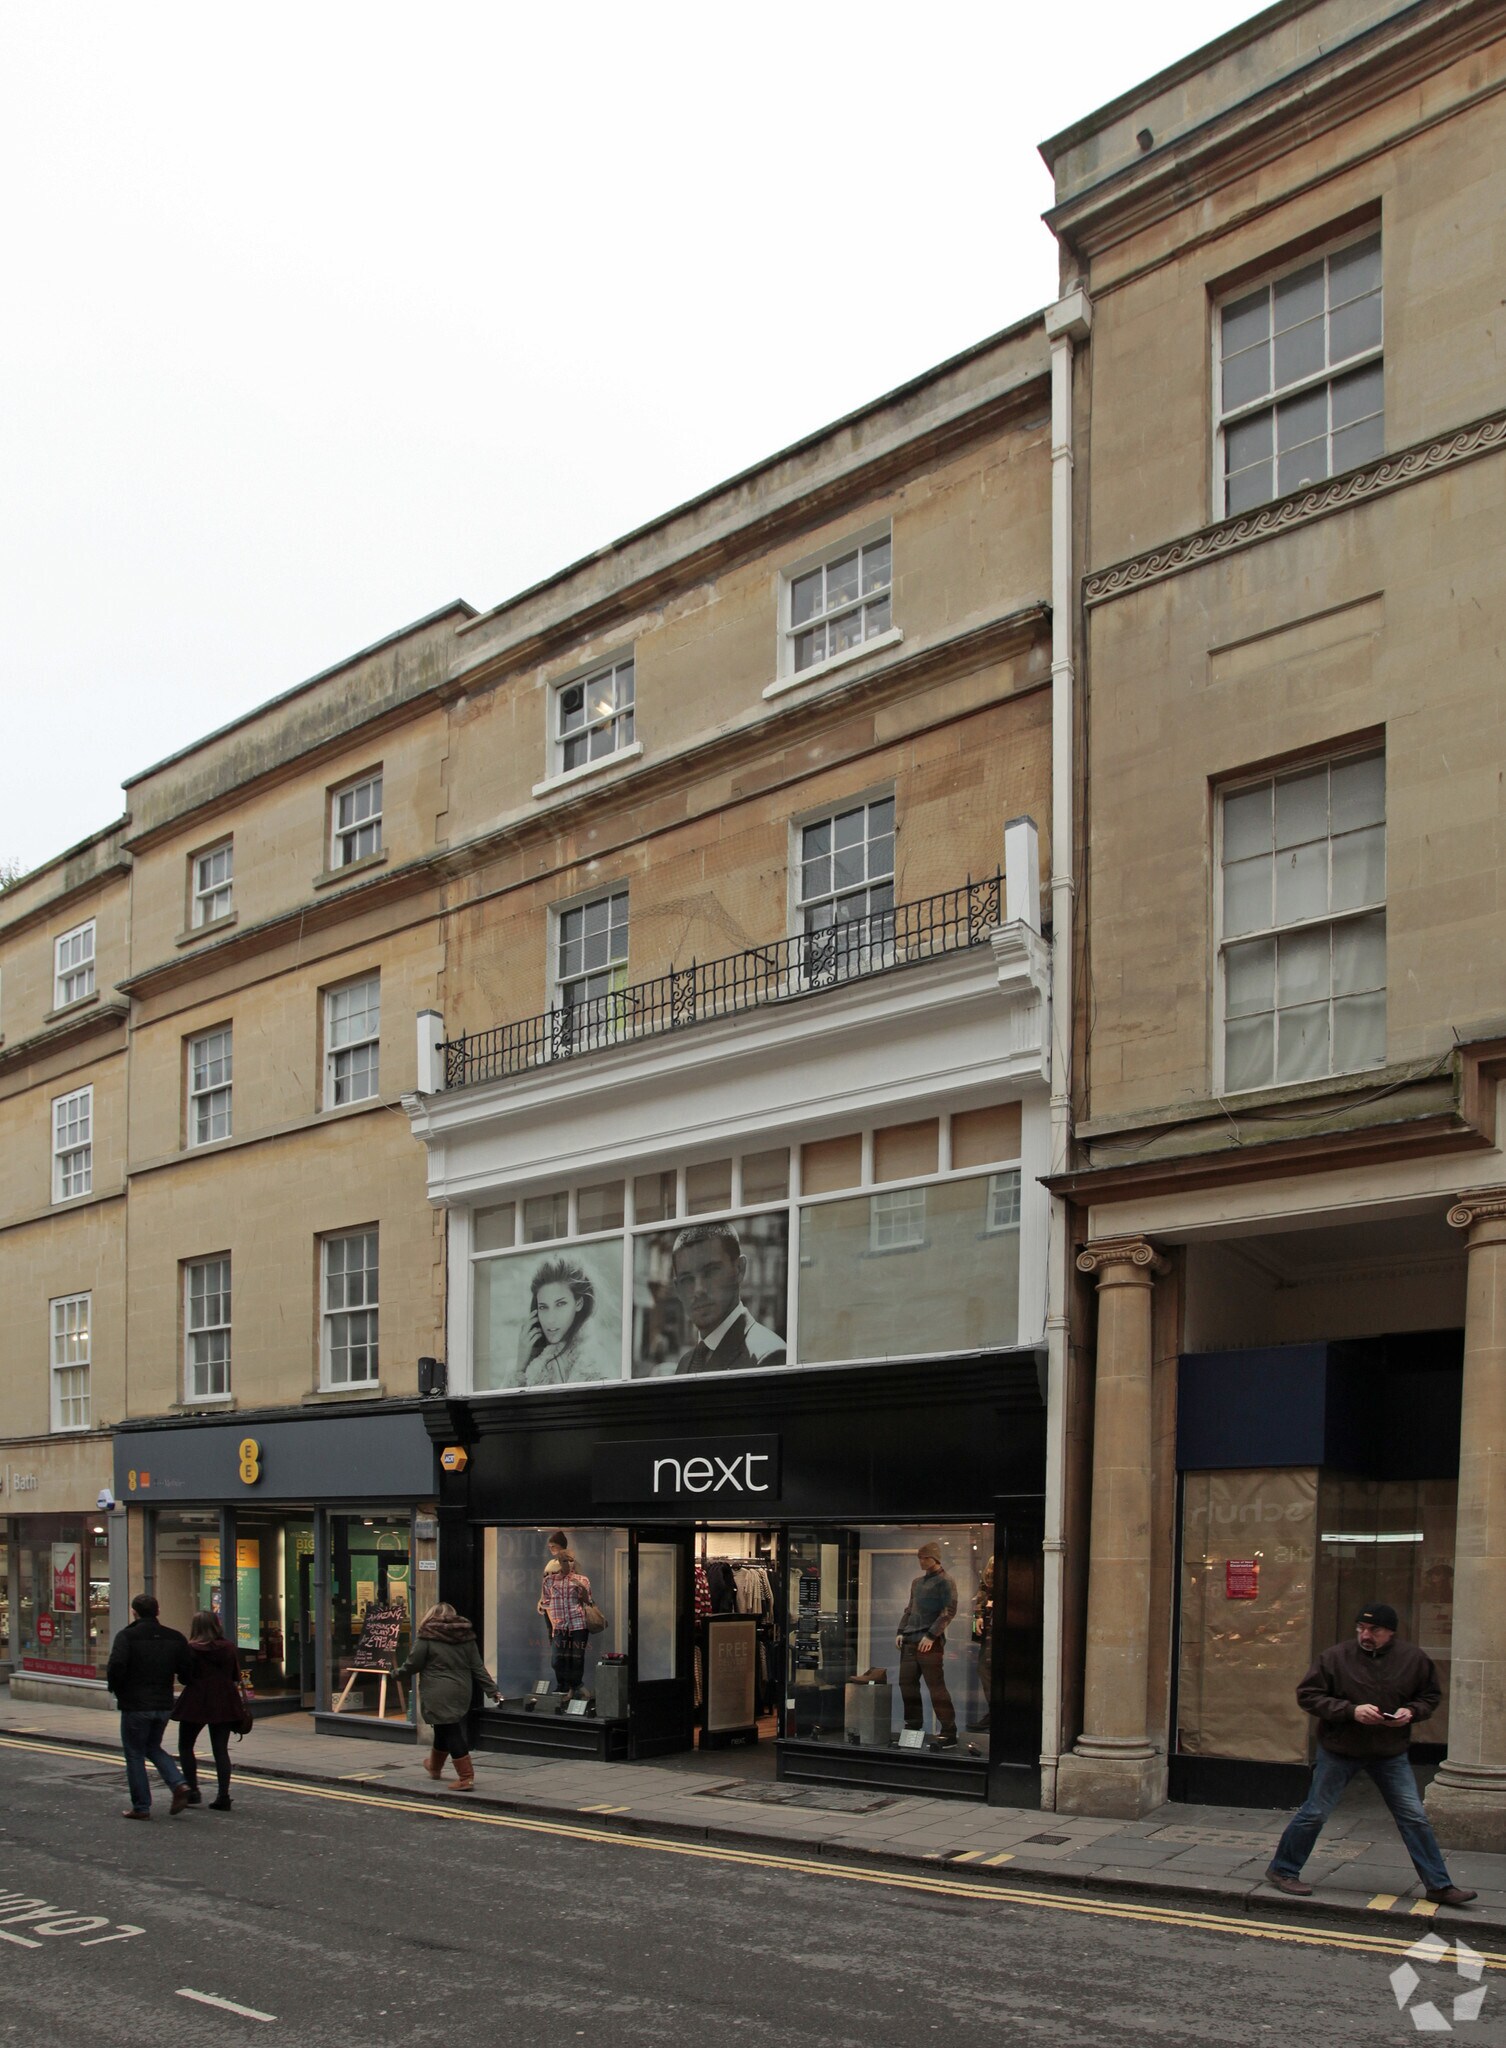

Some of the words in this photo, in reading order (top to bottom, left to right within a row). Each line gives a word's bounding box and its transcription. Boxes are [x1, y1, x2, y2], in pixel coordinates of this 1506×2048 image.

[653, 1453, 769, 1493] next
[13, 1473, 37, 1490] Bath
[213, 1545, 246, 1561] SE
[718, 1641, 748, 1657] FREE
